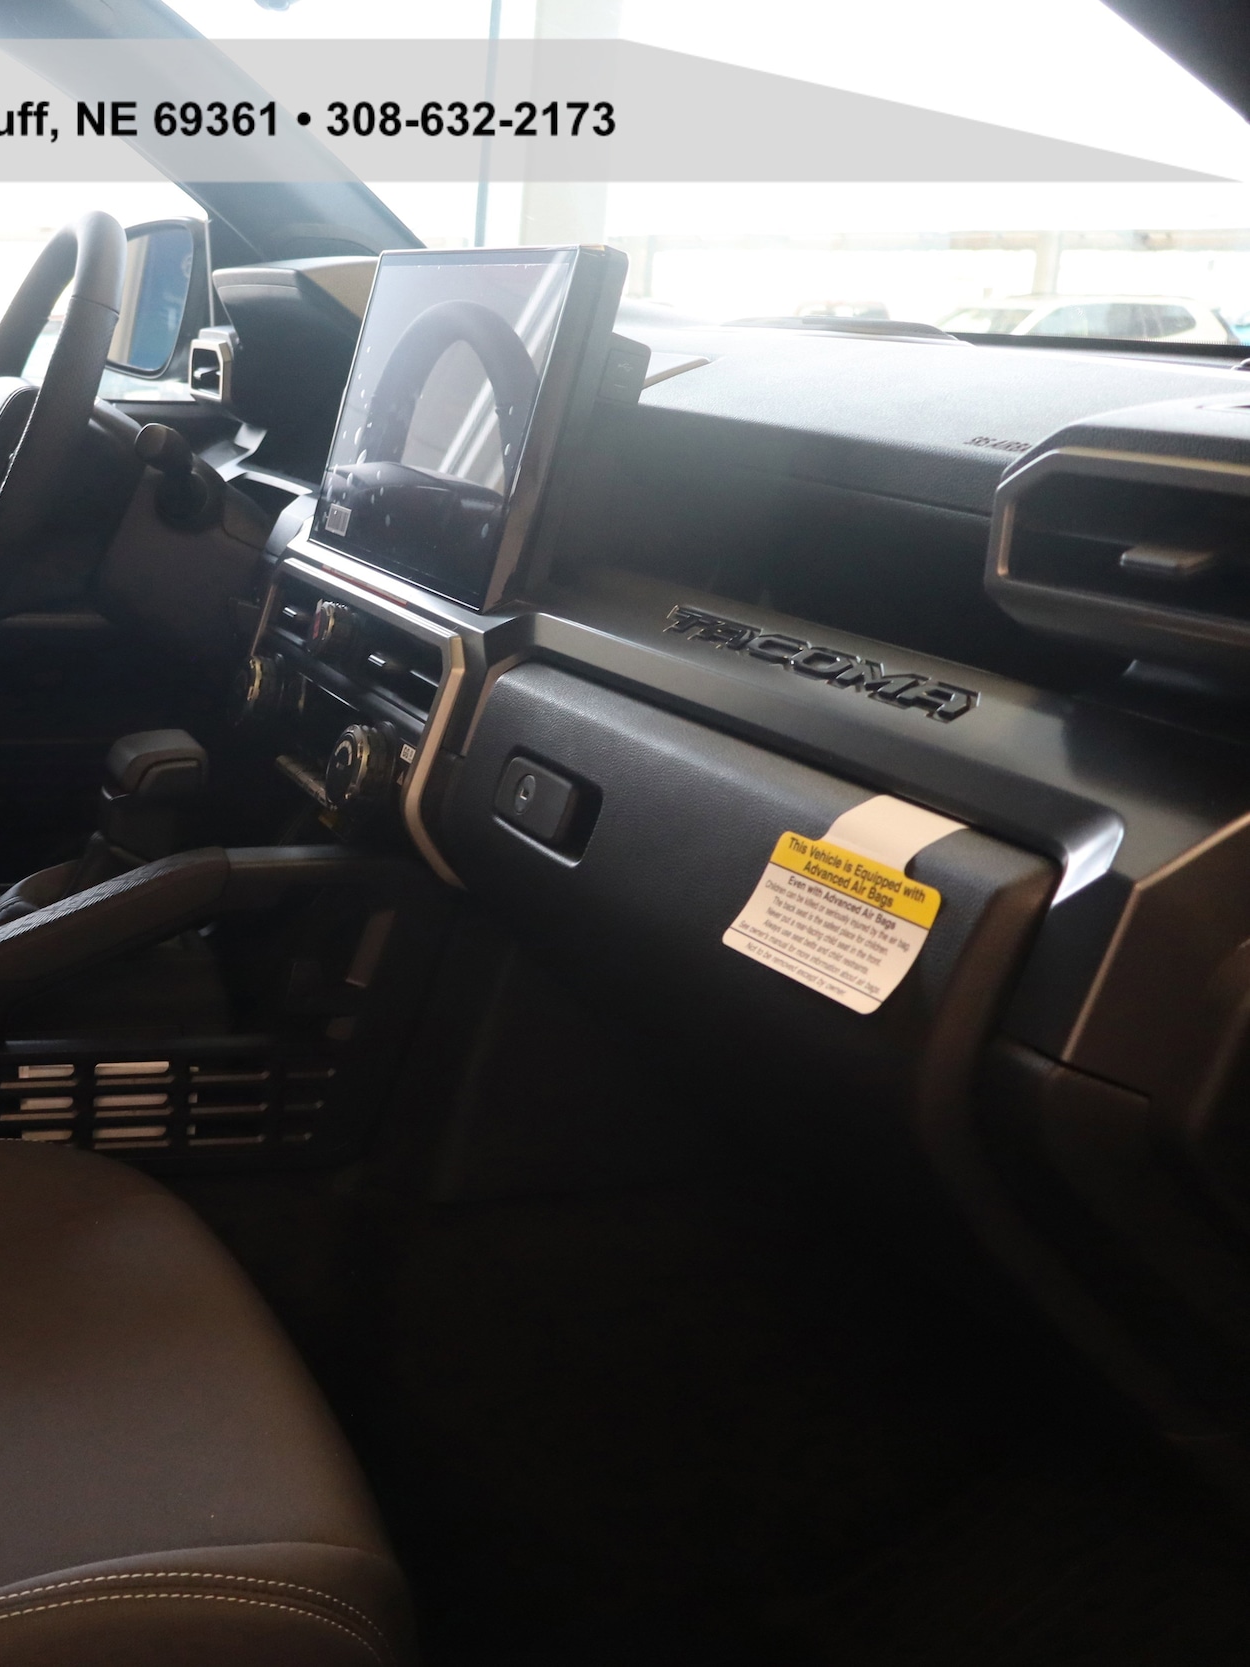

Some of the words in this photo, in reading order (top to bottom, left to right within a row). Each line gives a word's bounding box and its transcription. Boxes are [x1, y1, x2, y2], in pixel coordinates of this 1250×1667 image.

[662, 604, 981, 723] TACOMA
[789, 836, 807, 854] This
[809, 845, 842, 868] Vehicle
[842, 859, 853, 873] is
[854, 864, 902, 893] Equipped
[903, 886, 925, 903] with
[803, 861, 851, 889] Advanced
[850, 880, 867, 895] Air
[867, 886, 893, 908] Bags
[765, 879, 786, 894] Children
[785, 890, 797, 899] can
[795, 893, 804, 903] be
[804, 897, 819, 909] killed
[825, 908, 850, 924] seriously
[766, 906, 782, 919] Never
[773, 895, 783, 907] The
[782, 901, 796, 912] back
[787, 875, 806, 890] Even
[807, 885, 823, 897] with
[823, 891, 862, 914] Advanced
[861, 908, 875, 919] Air
[875, 913, 896, 930] Bags
